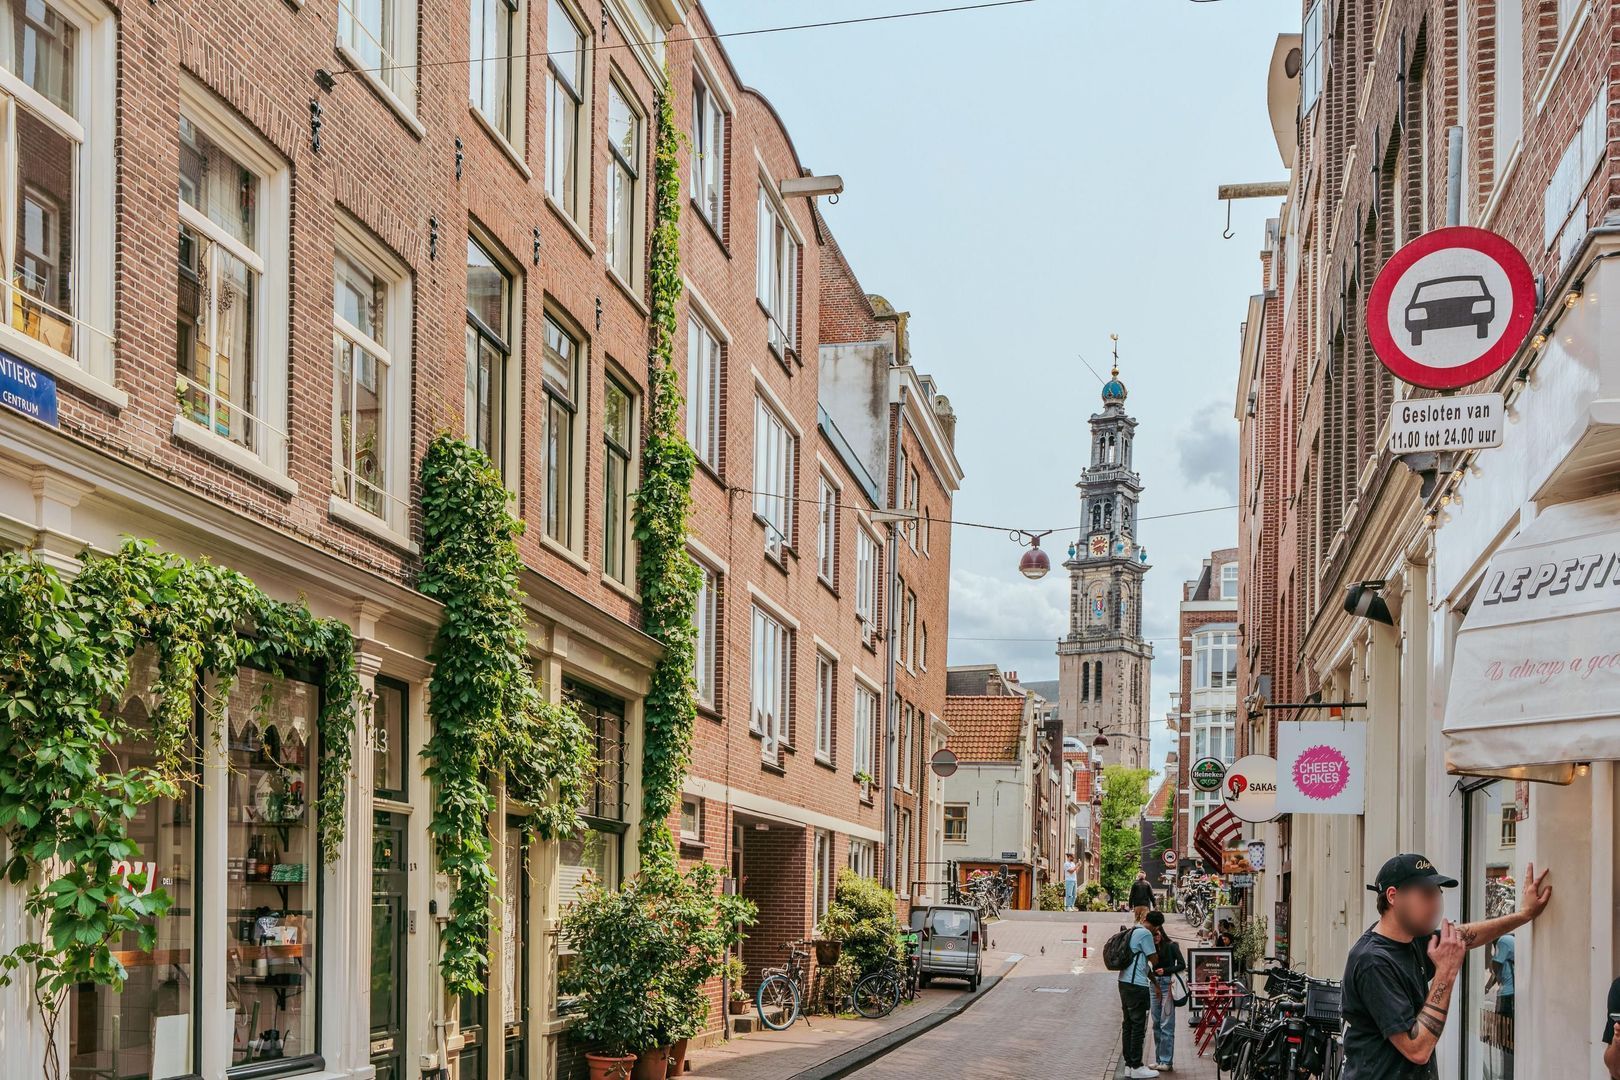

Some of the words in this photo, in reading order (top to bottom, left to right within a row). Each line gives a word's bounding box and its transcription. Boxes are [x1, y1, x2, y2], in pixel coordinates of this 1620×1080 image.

[2, 390, 39, 416] CENTRUM
[1402, 404, 1461, 424] Gesloten
[1467, 404, 1490, 419] van
[1391, 430, 1420, 449] 11.00
[1424, 430, 1440, 447] tot
[1444, 426, 1474, 446] 24.00
[1478, 429, 1497, 443] uur
[1527, 551, 1620, 600] PETI
[1508, 658, 1566, 685] always
[1569, 656, 1583, 672] a
[374, 727, 388, 753] 13
[1299, 761, 1343, 774] CHEESY
[1302, 772, 1340, 785] CAKES
